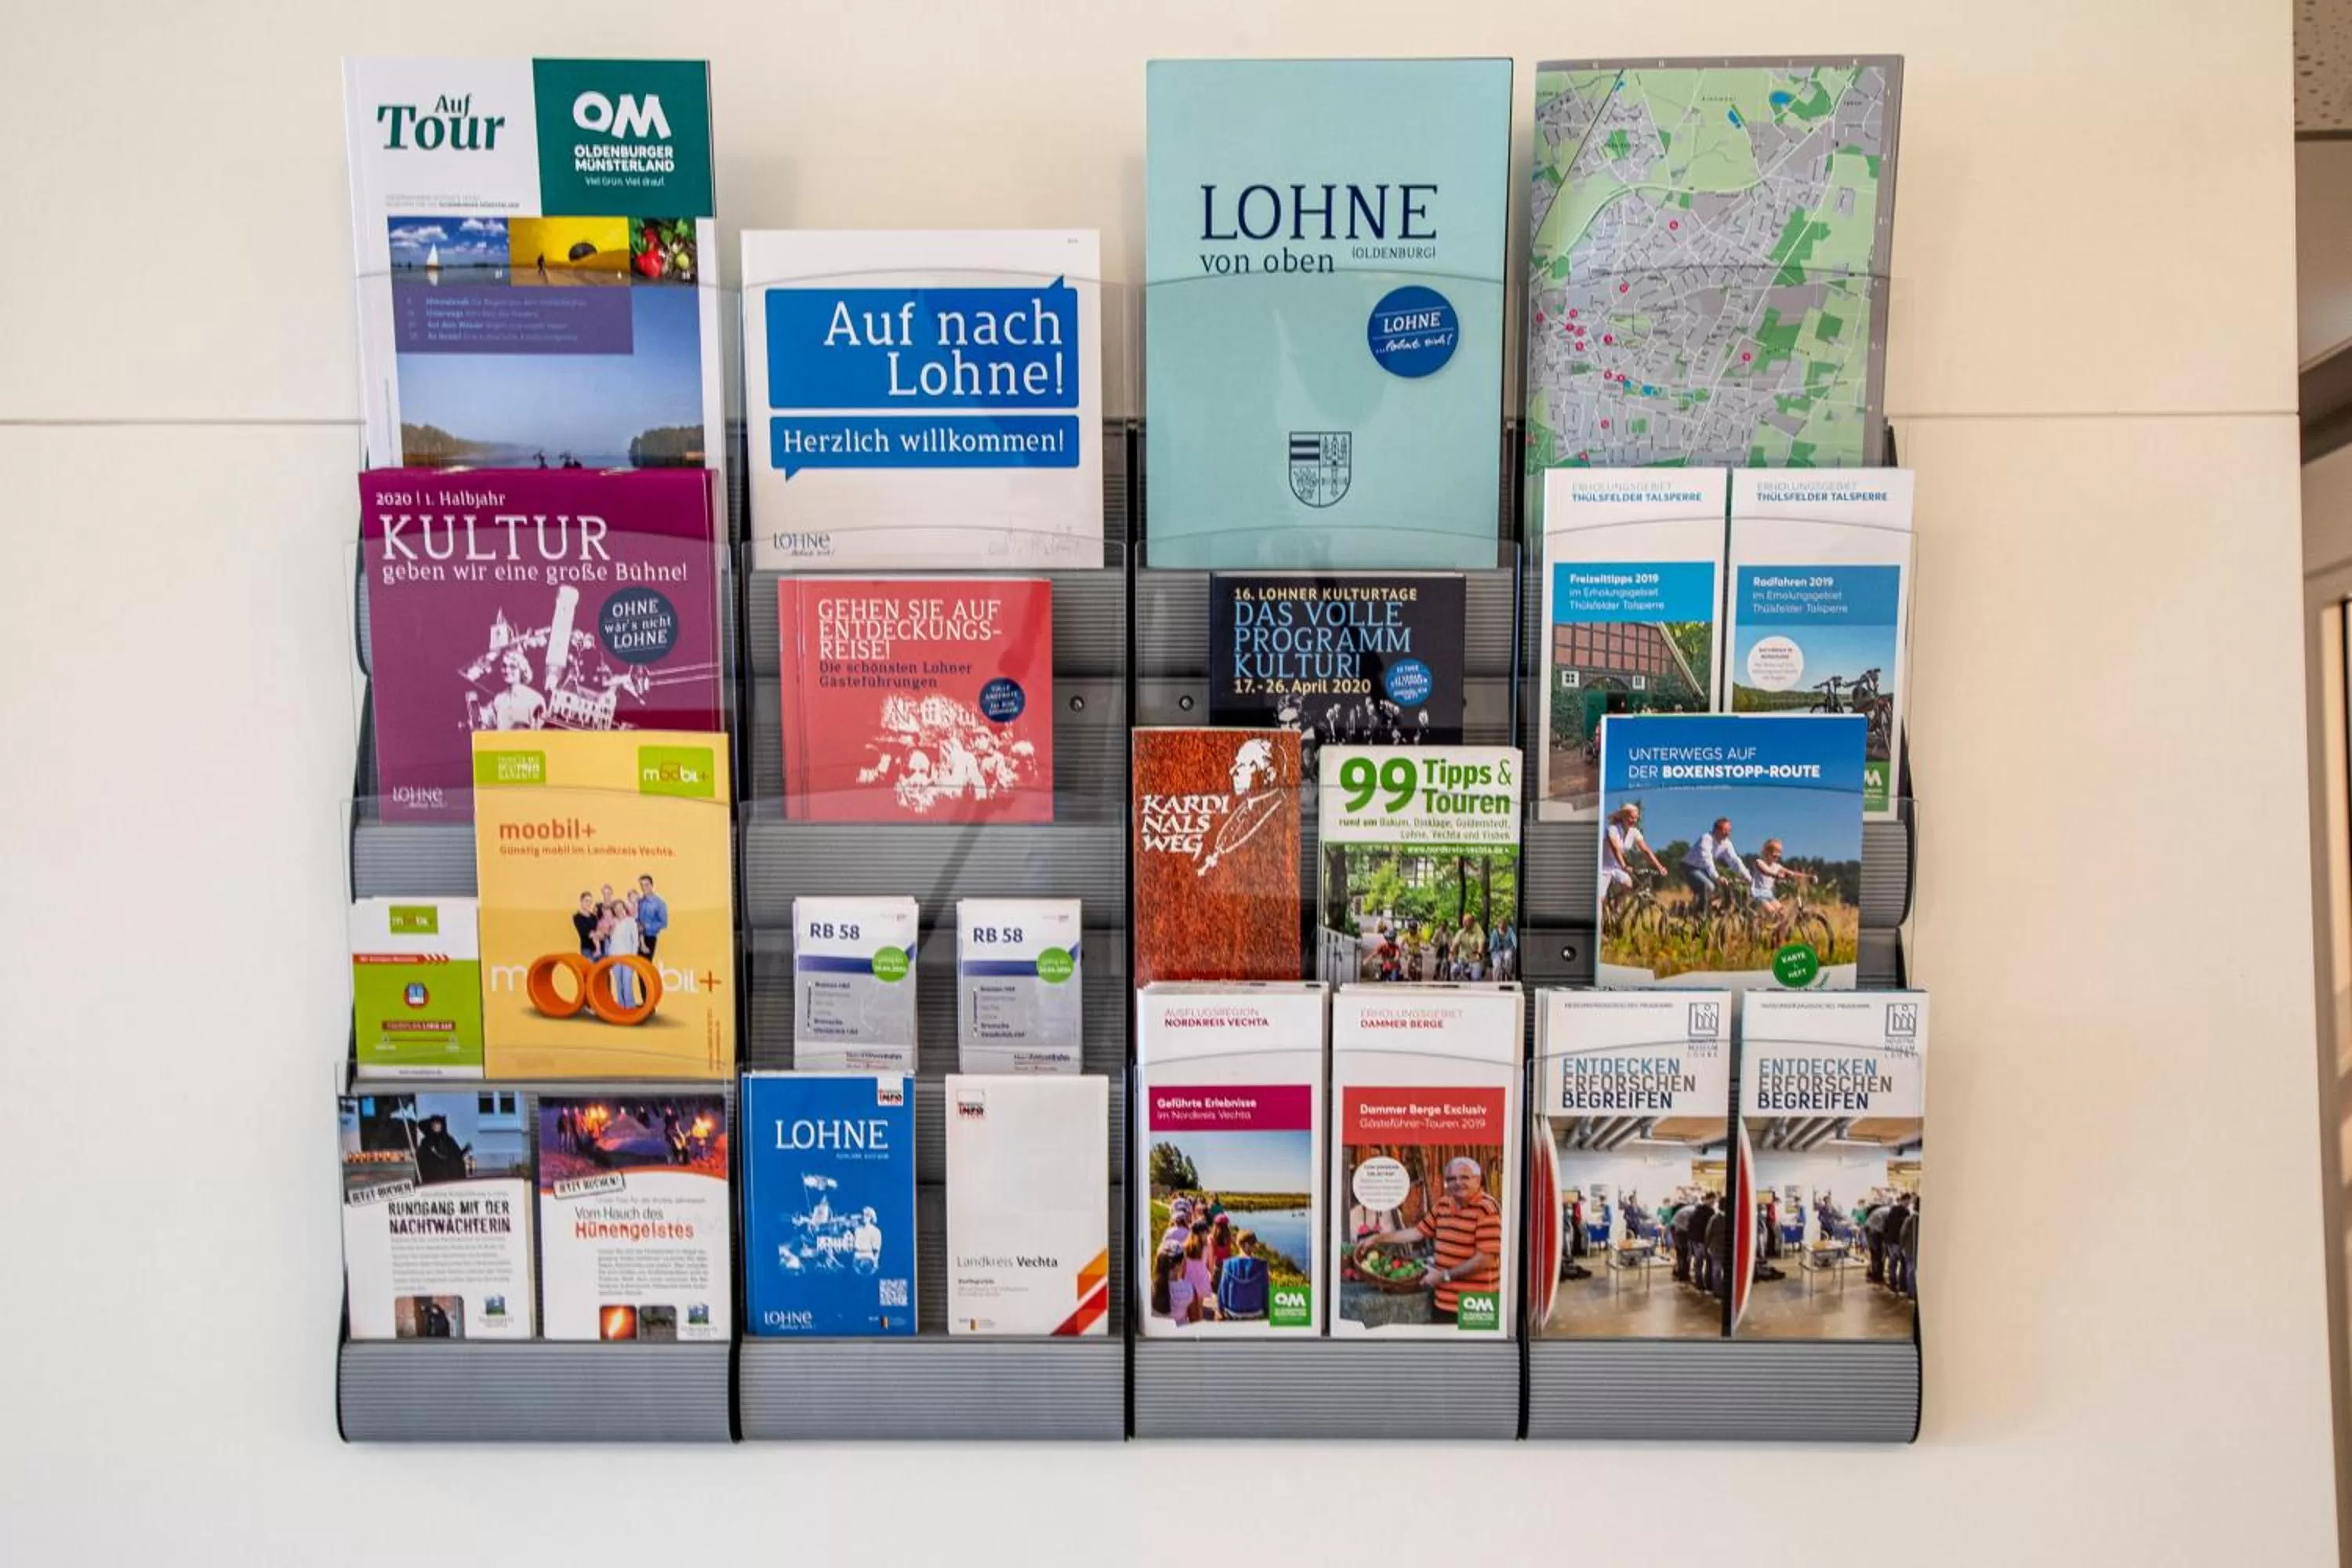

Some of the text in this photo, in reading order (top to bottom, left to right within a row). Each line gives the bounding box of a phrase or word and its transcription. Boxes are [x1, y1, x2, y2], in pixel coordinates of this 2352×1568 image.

[434, 93, 471, 118] Auf
[573, 90, 672, 140] OM
[377, 105, 505, 151] Tour
[574, 143, 673, 158] OLDENBURGER
[575, 157, 675, 172] MÜNSTERLAND
[1200, 184, 1439, 241] LOHNE
[1200, 248, 1335, 274] von oben
[823, 298, 1062, 346] Auf nach
[1384, 311, 1441, 333] LOHNE
[887, 350, 1063, 397] Lohne!
[783, 428, 1064, 453] Herzlich willkommen!
[1572, 481, 1671, 491] ERHOLUNGSGEBIET
[376, 492, 412, 506] 2020
[426, 492, 435, 506] 1.
[440, 492, 506, 509] Halbjahr
[1571, 492, 1702, 502] THÜLSFELDER TALSPERRE
[1756, 491, 1887, 502] THÜLSFELDER TALSPERRE
[379, 514, 610, 561] KULTUR
[383, 561, 688, 585] geben wir eine große Bühne!
[1570, 573, 1659, 586] Freizeittipps 2019
[1753, 576, 1834, 587] Radfahren 2019
[1234, 588, 1417, 601] 16. LOHNER KULTURTAGE
[1570, 587, 1658, 600] im Erholungsgebiet
[1753, 590, 1842, 603] im Erholungsgebiet
[612, 597, 659, 618] OHNE
[818, 599, 1001, 620] GEHEN SIE AUF
[1234, 601, 1403, 627] DAS VOLLE
[1570, 600, 1664, 612] Thülsfelder Talsperre
[1753, 602, 1848, 615] Thülsfelder Talsperre
[643, 615, 671, 629] nicht
[819, 620, 1002, 641] ENTDECKUNGS-
[614, 629, 667, 648] LOHNE
[1234, 627, 1411, 653] PROGRAMM
[819, 640, 891, 659] REISE!
[819, 661, 973, 674] Die schönsten Lohner
[1234, 652, 1361, 679] KULTUR!
[819, 675, 938, 690] Gästeführungen
[1292, 679, 1328, 696] April
[1333, 680, 1371, 694] 2020
[1629, 747, 1756, 760] UNTERWEGS AUF
[1628, 764, 1820, 779] DER BOXENSTOPP-ROUTE
[1340, 757, 1512, 814] 99 Tipps &
[1142, 794, 1229, 813] KARDI
[1422, 789, 1510, 815] Touren
[499, 818, 597, 840] moobil+
[1142, 814, 1210, 833] NALS
[1483, 831, 1510, 840] Visbek
[499, 844, 677, 858] Günstig mobil im Landkreis Vechta.
[1142, 833, 1203, 858] WEG
[810, 923, 860, 940] RB 58
[973, 928, 1023, 942] RB 58
[1165, 1018, 1269, 1028] NORDKREIS VECHTA
[1360, 1019, 1443, 1029] DAMMER BERGE
[1563, 1058, 1680, 1076] ENTDECKEN
[1759, 1058, 1877, 1076] ENTDECKEN
[1563, 1075, 1696, 1092] ERFORSCHEN
[1759, 1075, 1893, 1093] ERFORSCHEN
[1157, 1098, 1257, 1109] Geführte Erlebnisse
[1562, 1092, 1672, 1109] BEGREIFEN
[1758, 1093, 1869, 1109] BEGREIFEN
[1157, 1110, 1251, 1120] im Nordkreis Vechta
[1360, 1104, 1406, 1116] Dammer
[1410, 1105, 1441, 1118] Berge
[1461, 1118, 1486, 1129] 2019
[775, 1120, 888, 1150] LOHNE
[388, 1200, 510, 1215] RUNDGANG MIT DER
[575, 1206, 664, 1220] Vom Hauch des
[575, 1221, 695, 1240] Hünengeistes
[956, 1254, 1058, 1268] Landkreis Vechta
